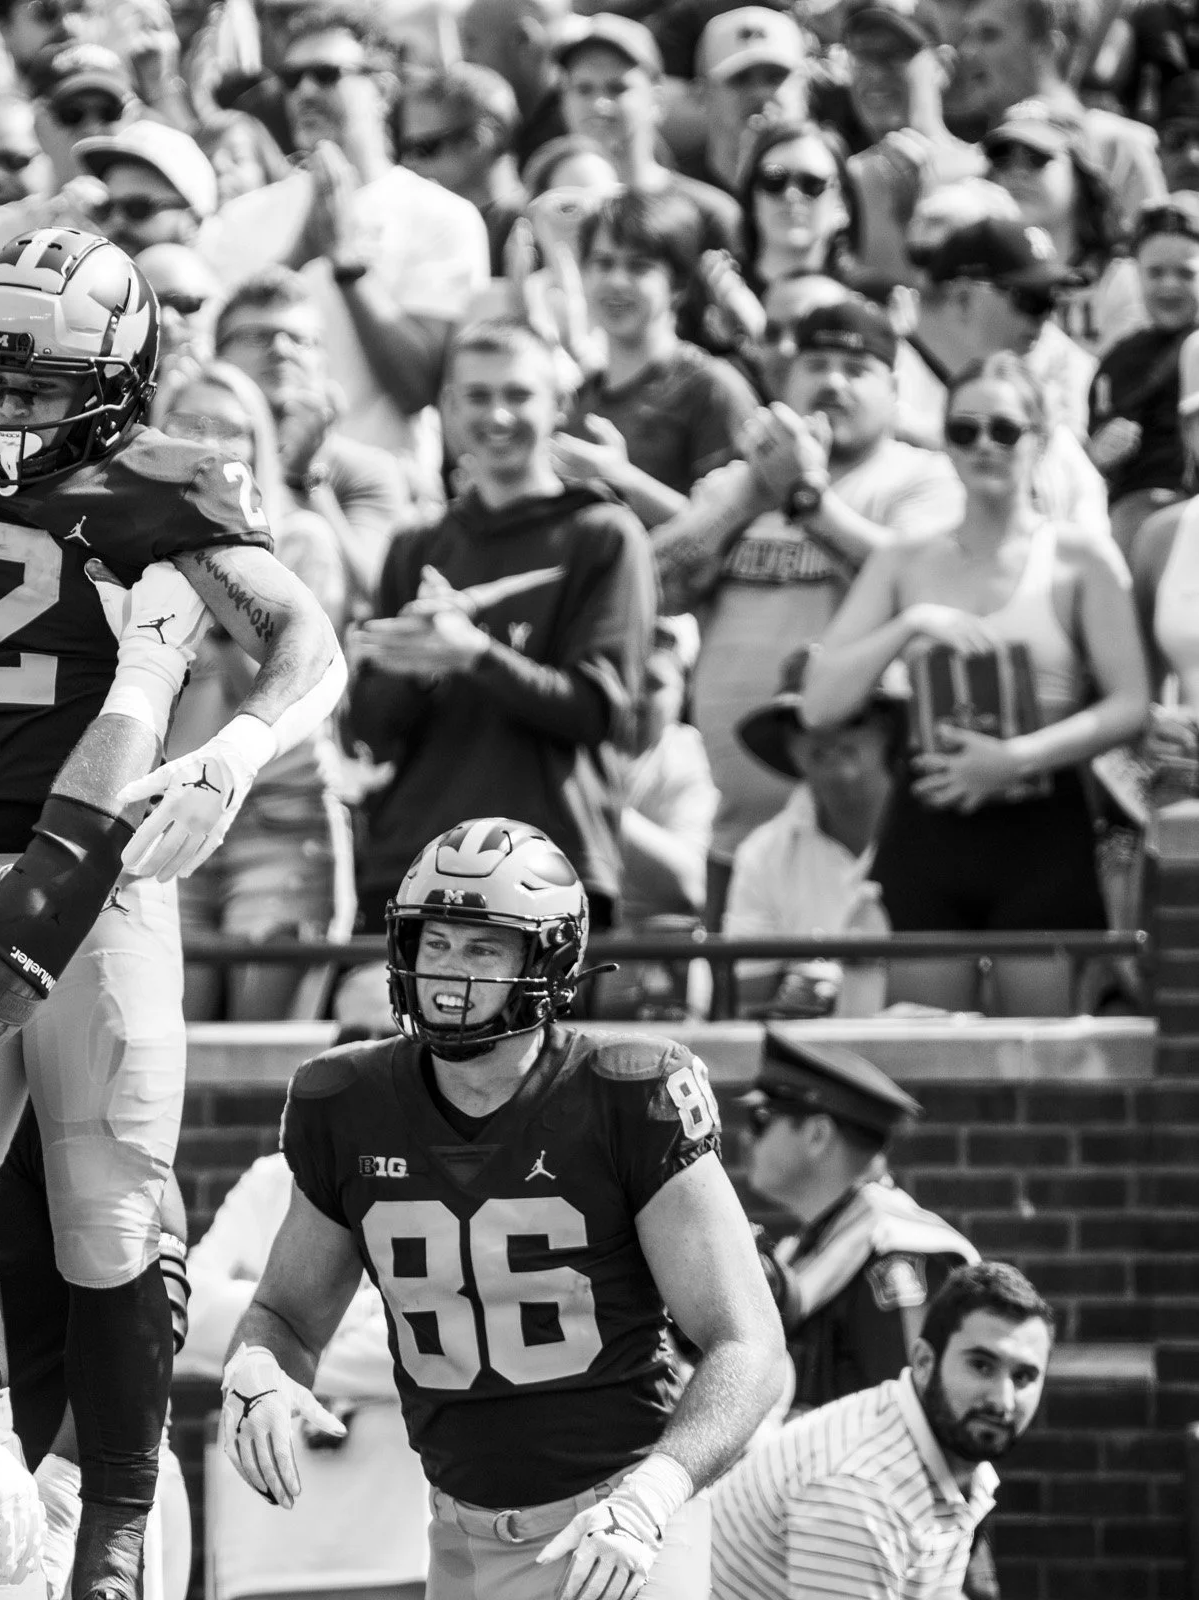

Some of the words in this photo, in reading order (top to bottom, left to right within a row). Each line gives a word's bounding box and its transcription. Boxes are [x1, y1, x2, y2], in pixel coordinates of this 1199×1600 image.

[223, 461, 268, 528] 2
[443, 889, 465, 904] M
[361, 1196, 603, 1391] 86
